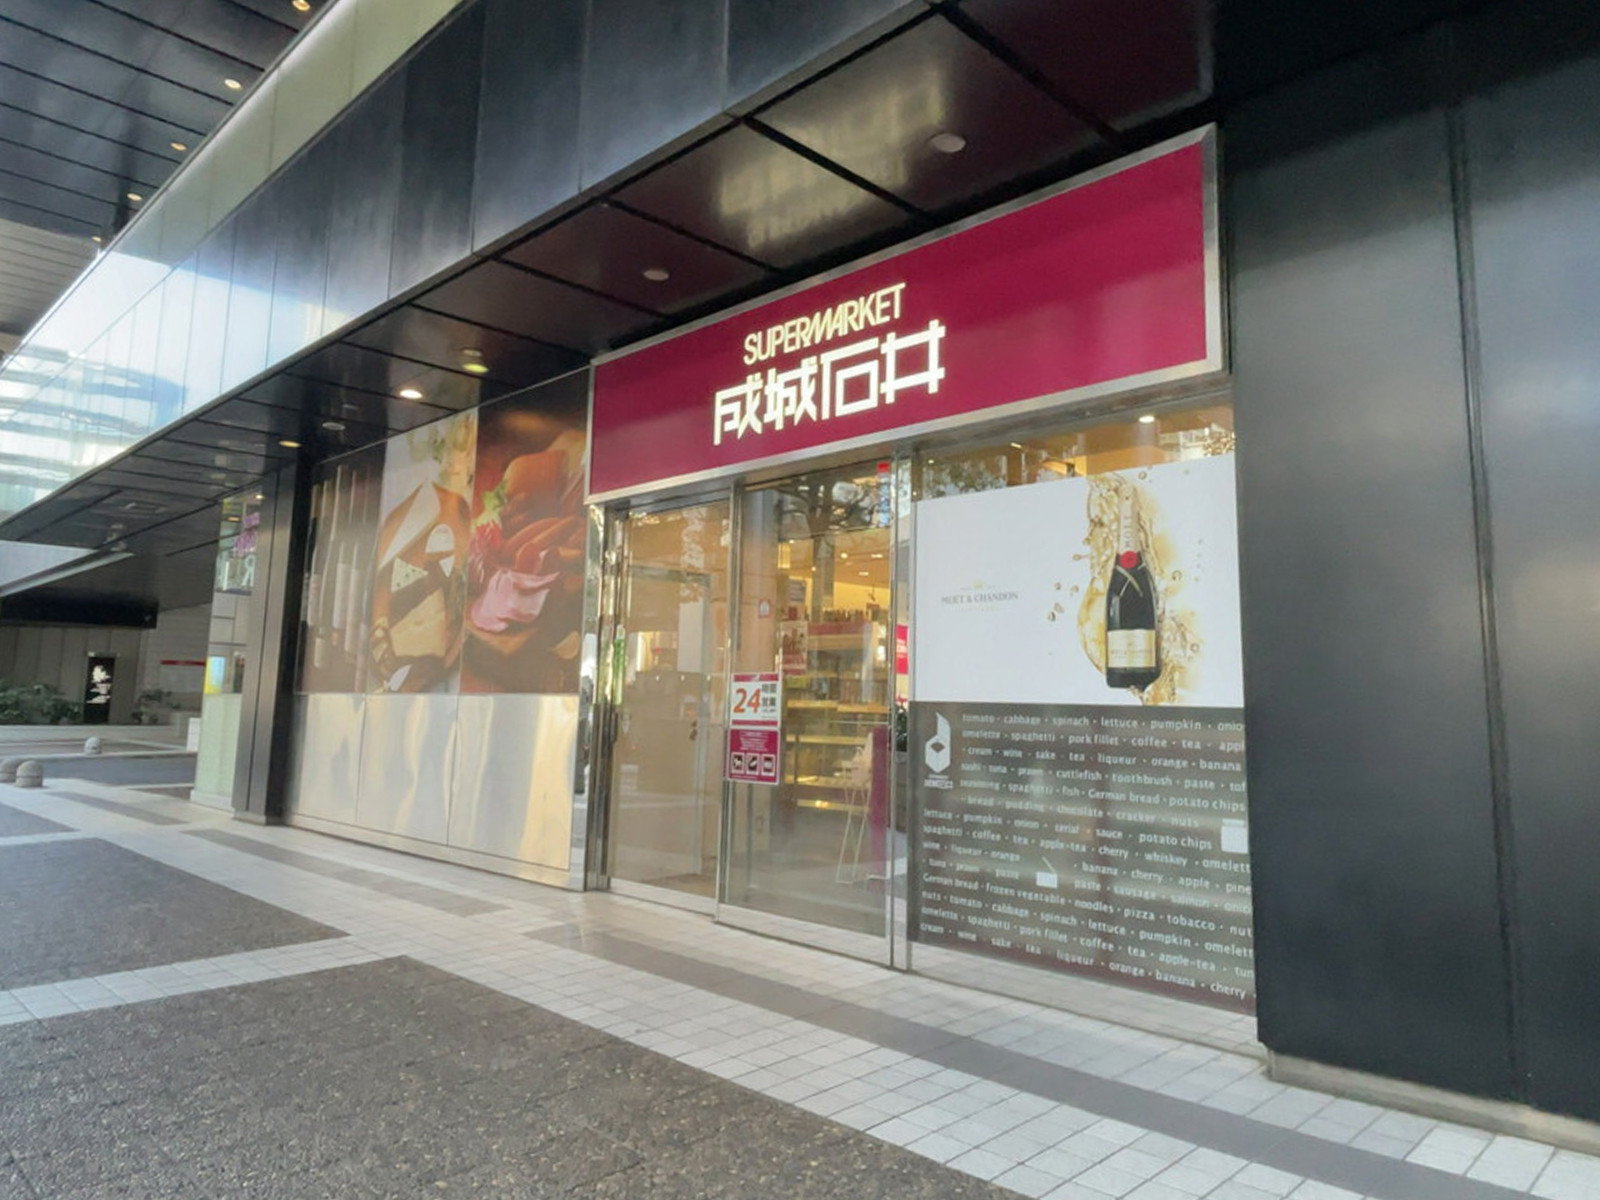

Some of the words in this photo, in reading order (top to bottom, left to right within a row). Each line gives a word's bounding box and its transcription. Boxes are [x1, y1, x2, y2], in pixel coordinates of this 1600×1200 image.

[743, 282, 907, 365] SUPERMARKET
[713, 318, 946, 446] 成城石井
[733, 687, 761, 713] 24
[1004, 715, 1041, 725] cabbage
[1053, 716, 1088, 727] spinach
[1101, 717, 1138, 728] lettuce
[1151, 719, 1202, 731] pumpkin
[1218, 721, 1243, 731] onio
[1011, 732, 1055, 742] spaghetti
[1068, 734, 1092, 745] pork
[1131, 736, 1168, 747] coffee
[1182, 739, 1201, 749] tea
[1036, 750, 1055, 760] sake
[1069, 752, 1085, 761] tea
[1097, 753, 1136, 766] liqueur
[1151, 757, 1188, 768] orange
[1200, 759, 1241, 771] banana
[1062, 786, 1080, 796] fish
[1088, 789, 1126, 800] German
[1129, 792, 1160, 804] bread
[1169, 795, 1209, 808] potato
[1212, 799, 1246, 811] chips
[1112, 773, 1172, 786] toothbrush
[1184, 779, 1215, 790] paste
[963, 813, 1002, 825] pumpkin
[1096, 828, 1123, 839] sauce
[1139, 833, 1178, 845] potato
[1180, 836, 1212, 849] chips
[1116, 811, 1155, 823] cracker
[1171, 816, 1199, 827] nuts
[972, 830, 1000, 841] coffee
[1013, 835, 1028, 845] tea
[1099, 846, 1129, 859] cherry
[1144, 852, 1188, 867] whiskey
[1202, 859, 1251, 874] omelett
[990, 850, 1020, 862] orange
[1082, 862, 1118, 876] banana
[1131, 869, 1164, 883] cherry
[1178, 876, 1210, 889] apple
[922, 872, 953, 886] German
[955, 877, 979, 891] bread
[986, 882, 1015, 896] frozen
[1017, 889, 1066, 905] vegetable
[1074, 898, 1114, 914] noodles
[1124, 907, 1155, 922] pizza
[1167, 914, 1216, 931] tobacco
[1113, 885, 1157, 899] sausage
[1170, 894, 1210, 908] salmon
[921, 891, 941, 901] nuts
[950, 895, 983, 908] tomato
[992, 903, 1030, 918] cabbage
[1040, 911, 1078, 926] spinach
[1088, 920, 1126, 935] lettuce
[1139, 929, 1191, 947] pumpkin
[921, 906, 958, 920] omelette
[968, 915, 1011, 930] spaghetti
[1019, 925, 1041, 938] pork
[1079, 936, 1114, 951] coffee
[1127, 945, 1146, 958] tea
[1158, 952, 1216, 972] apple-tea
[920, 922, 944, 934] cream
[991, 937, 1011, 948] sake
[1026, 943, 1041, 955] tea
[1056, 949, 1094, 966] liqueur
[1109, 961, 1145, 977] orange
[1156, 970, 1196, 988] banana
[1210, 981, 1246, 1000] cherry
